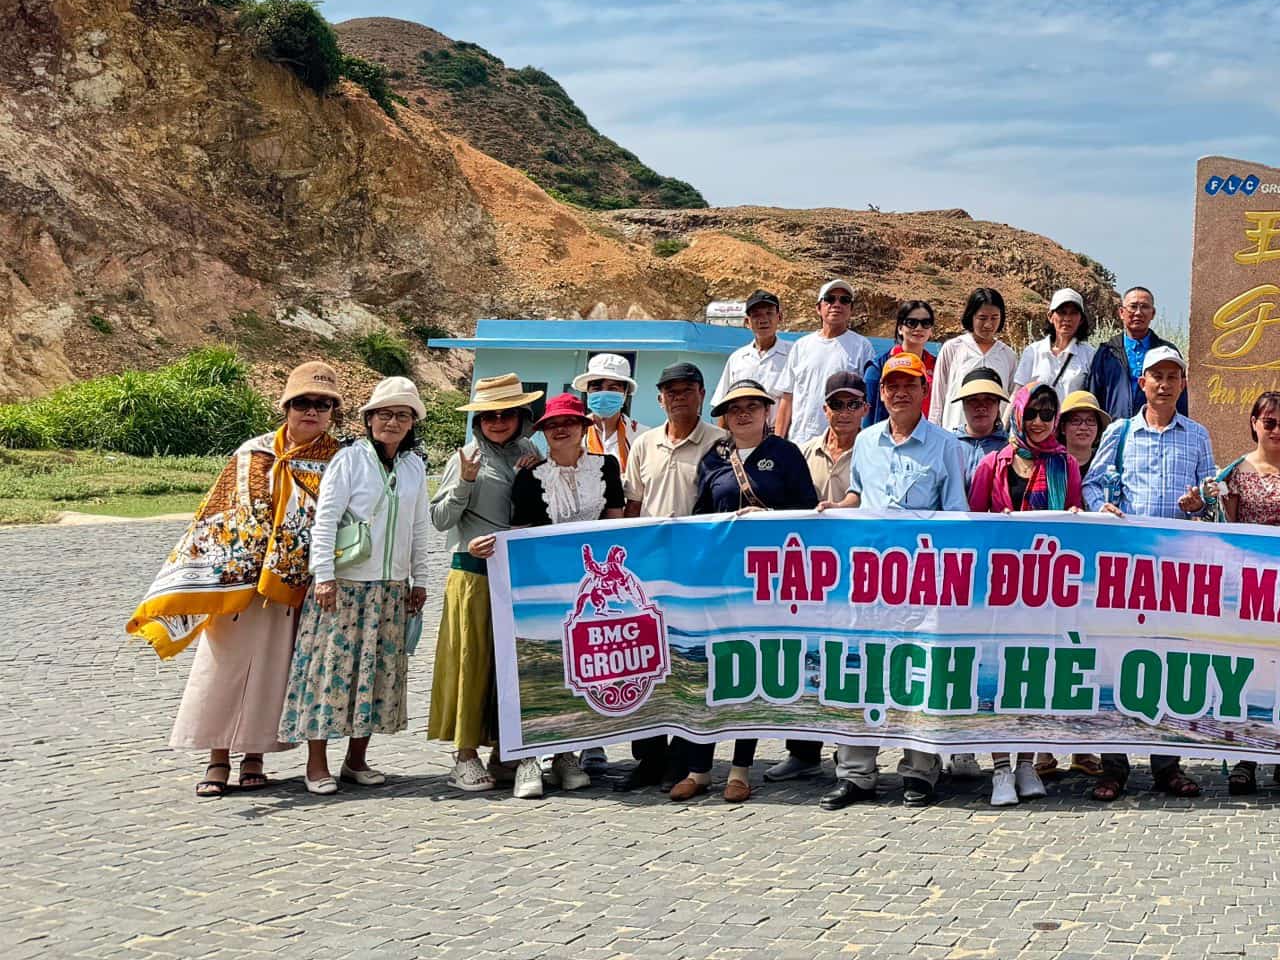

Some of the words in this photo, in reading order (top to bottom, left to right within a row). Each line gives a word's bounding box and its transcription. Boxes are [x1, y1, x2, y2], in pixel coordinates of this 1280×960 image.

[747, 536, 837, 615] TẬP
[851, 538, 973, 607] ĐOÀN
[988, 538, 1081, 608] ĐỨC
[1095, 556, 1223, 625] HẠNH
[579, 644, 656, 679] GROUP
[587, 622, 640, 646] BMG
[712, 639, 802, 702] DU
[823, 640, 977, 722] LỊCH
[1000, 631, 1097, 710] HÈ
[1119, 650, 1255, 721] QUY
